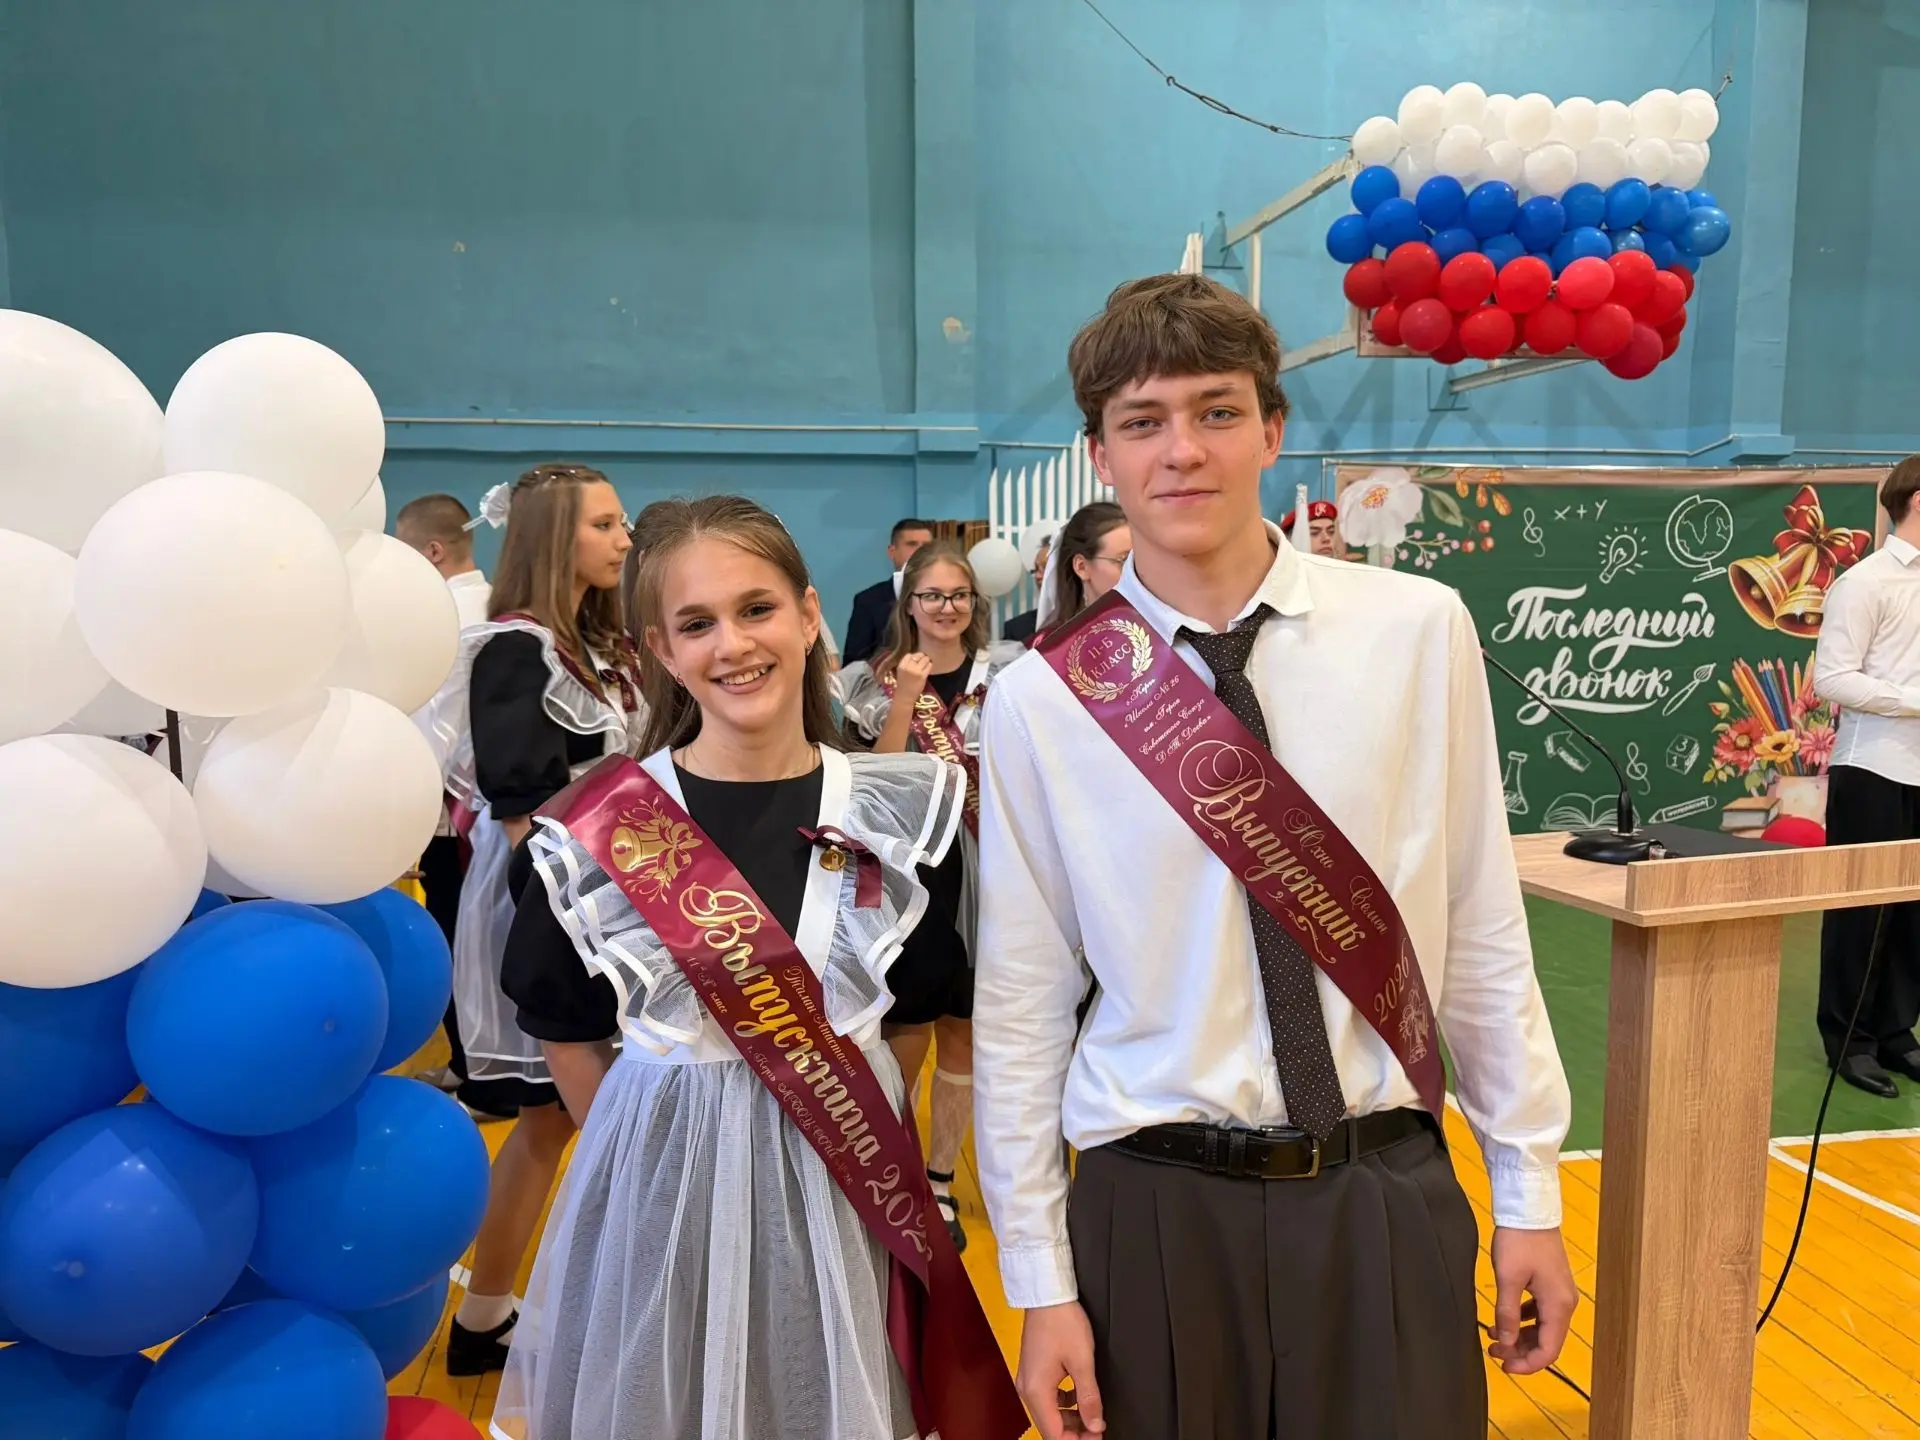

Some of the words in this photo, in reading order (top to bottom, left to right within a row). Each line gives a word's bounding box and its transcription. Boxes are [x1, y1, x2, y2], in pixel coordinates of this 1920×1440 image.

[1088, 636, 1114, 660] 11-Б
[1090, 643, 1132, 679] КЛАСС
[1491, 583, 1716, 672] Последний
[1170, 675, 1180, 688] 26
[1516, 646, 1673, 726] звонок
[1179, 740, 1366, 951] Выпускник
[1373, 937, 1410, 1028] 2026
[679, 882, 881, 1167] Выпускница
[865, 1164, 933, 1262] 202
[814, 1013, 858, 1079] Анастасия
